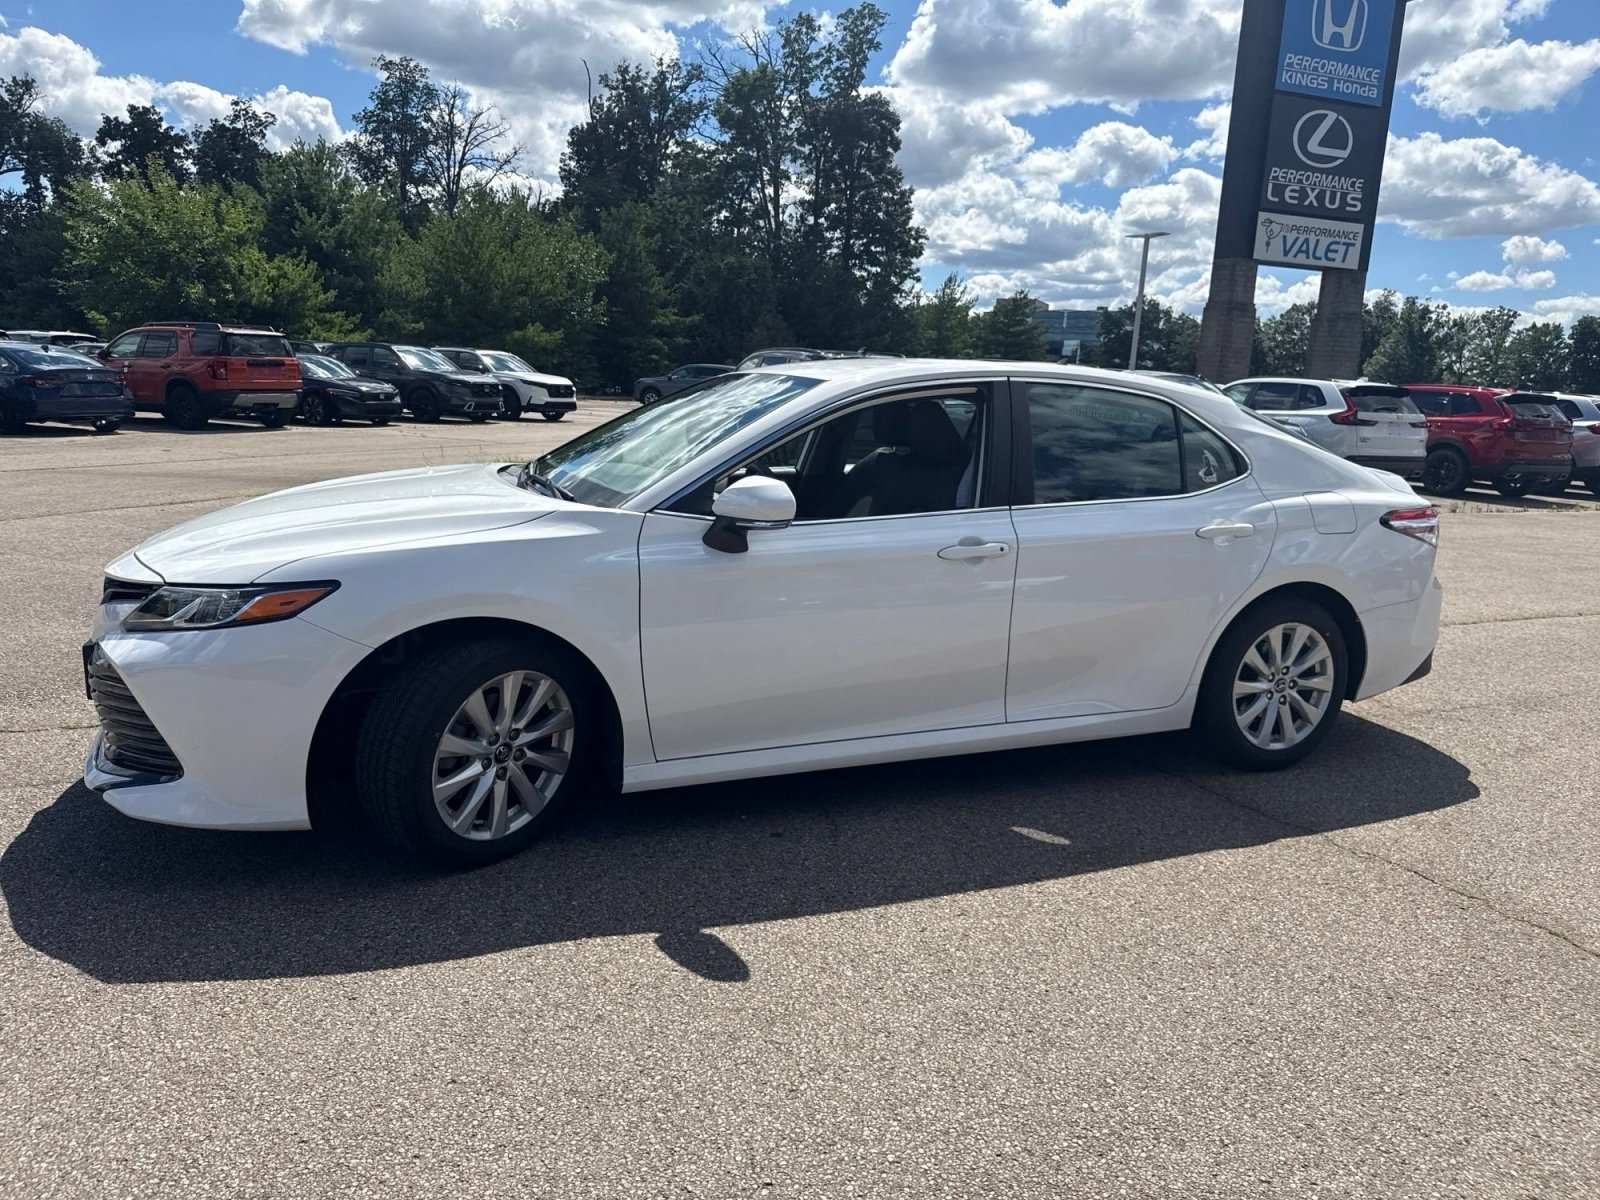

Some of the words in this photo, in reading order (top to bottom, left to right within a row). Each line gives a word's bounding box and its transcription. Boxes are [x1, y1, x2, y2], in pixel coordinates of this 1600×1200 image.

[1284, 53, 1381, 83] PERFORMANCE
[1282, 70, 1329, 90] KINGS
[1333, 79, 1378, 98] Honda
[1269, 167, 1364, 192] PERFORMANCE
[1267, 182, 1363, 212] LEXUS
[1289, 224, 1360, 241] PERFORMANCE
[1281, 234, 1356, 264] VALET
